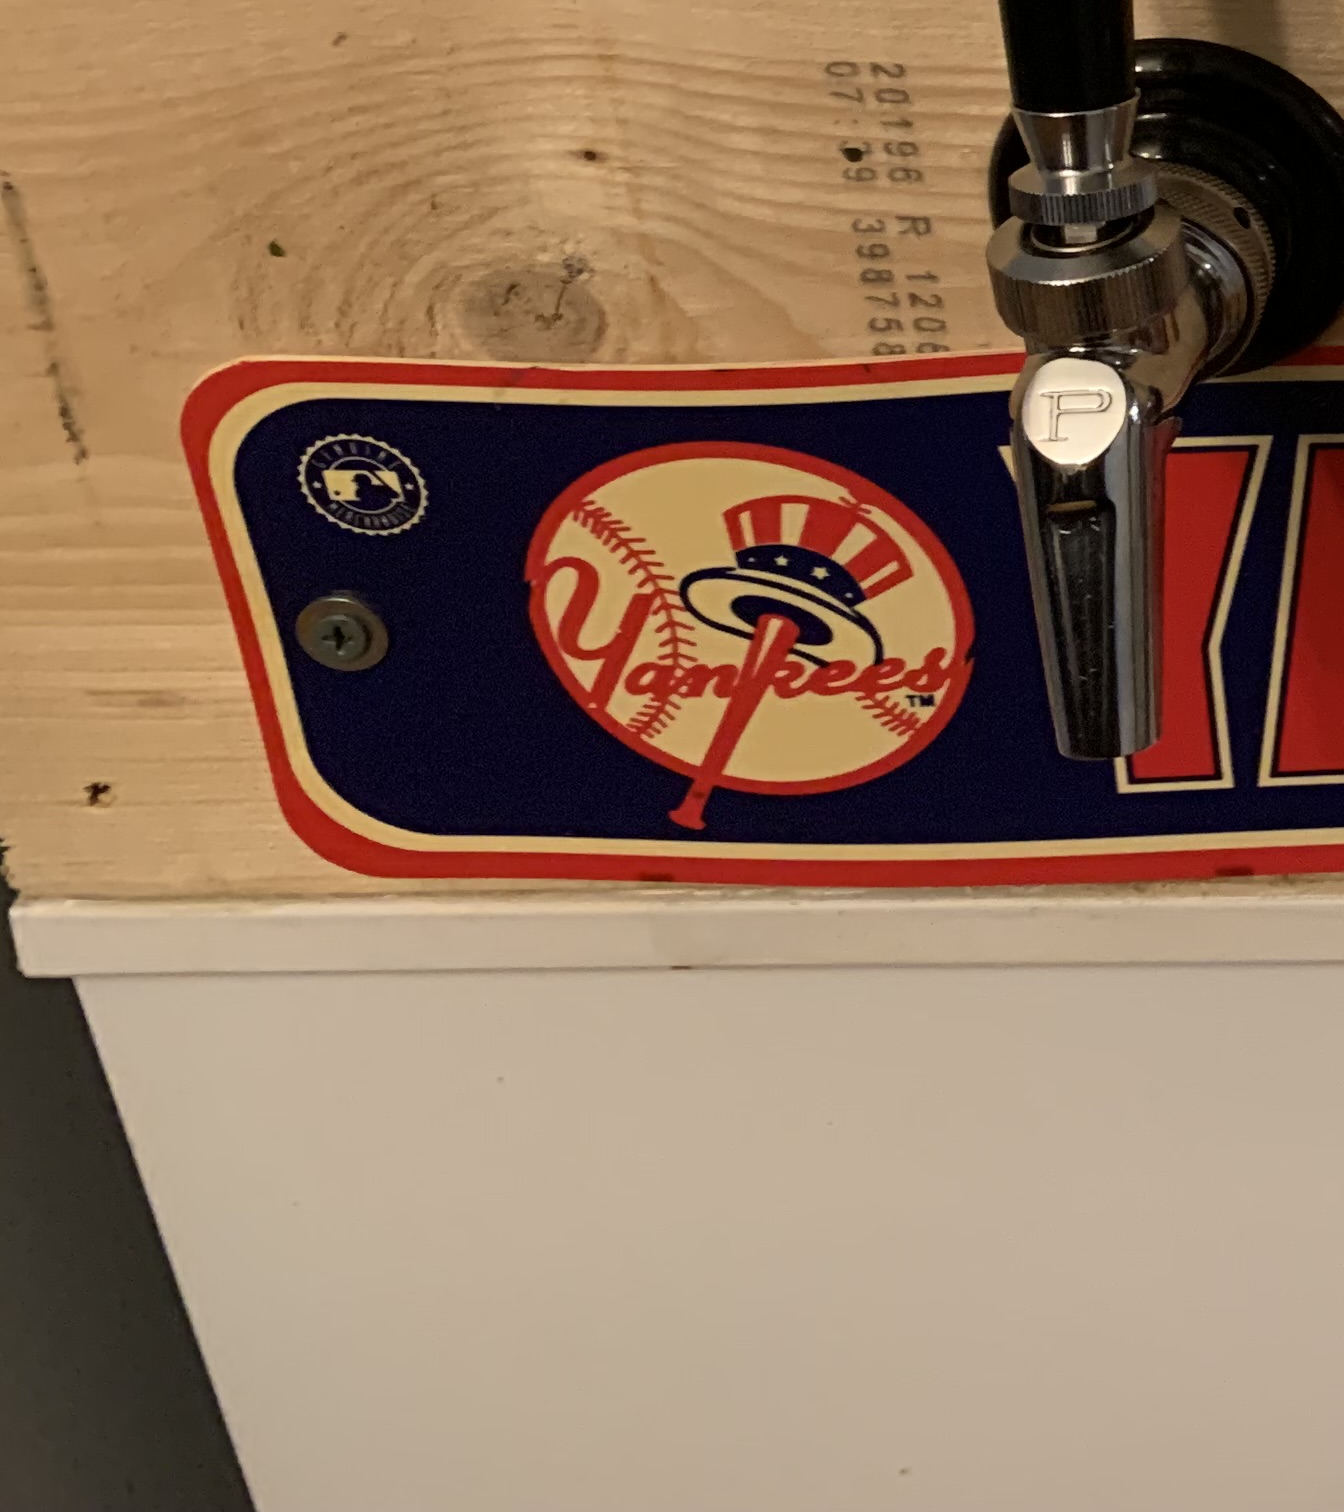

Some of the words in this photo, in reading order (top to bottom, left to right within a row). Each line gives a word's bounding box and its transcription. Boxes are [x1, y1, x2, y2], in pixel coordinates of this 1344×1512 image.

[895, 215, 932, 237] R
[852, 218, 907, 356] 398758
[1039, 389, 1113, 441] P
[543, 555, 951, 712] Yankees
